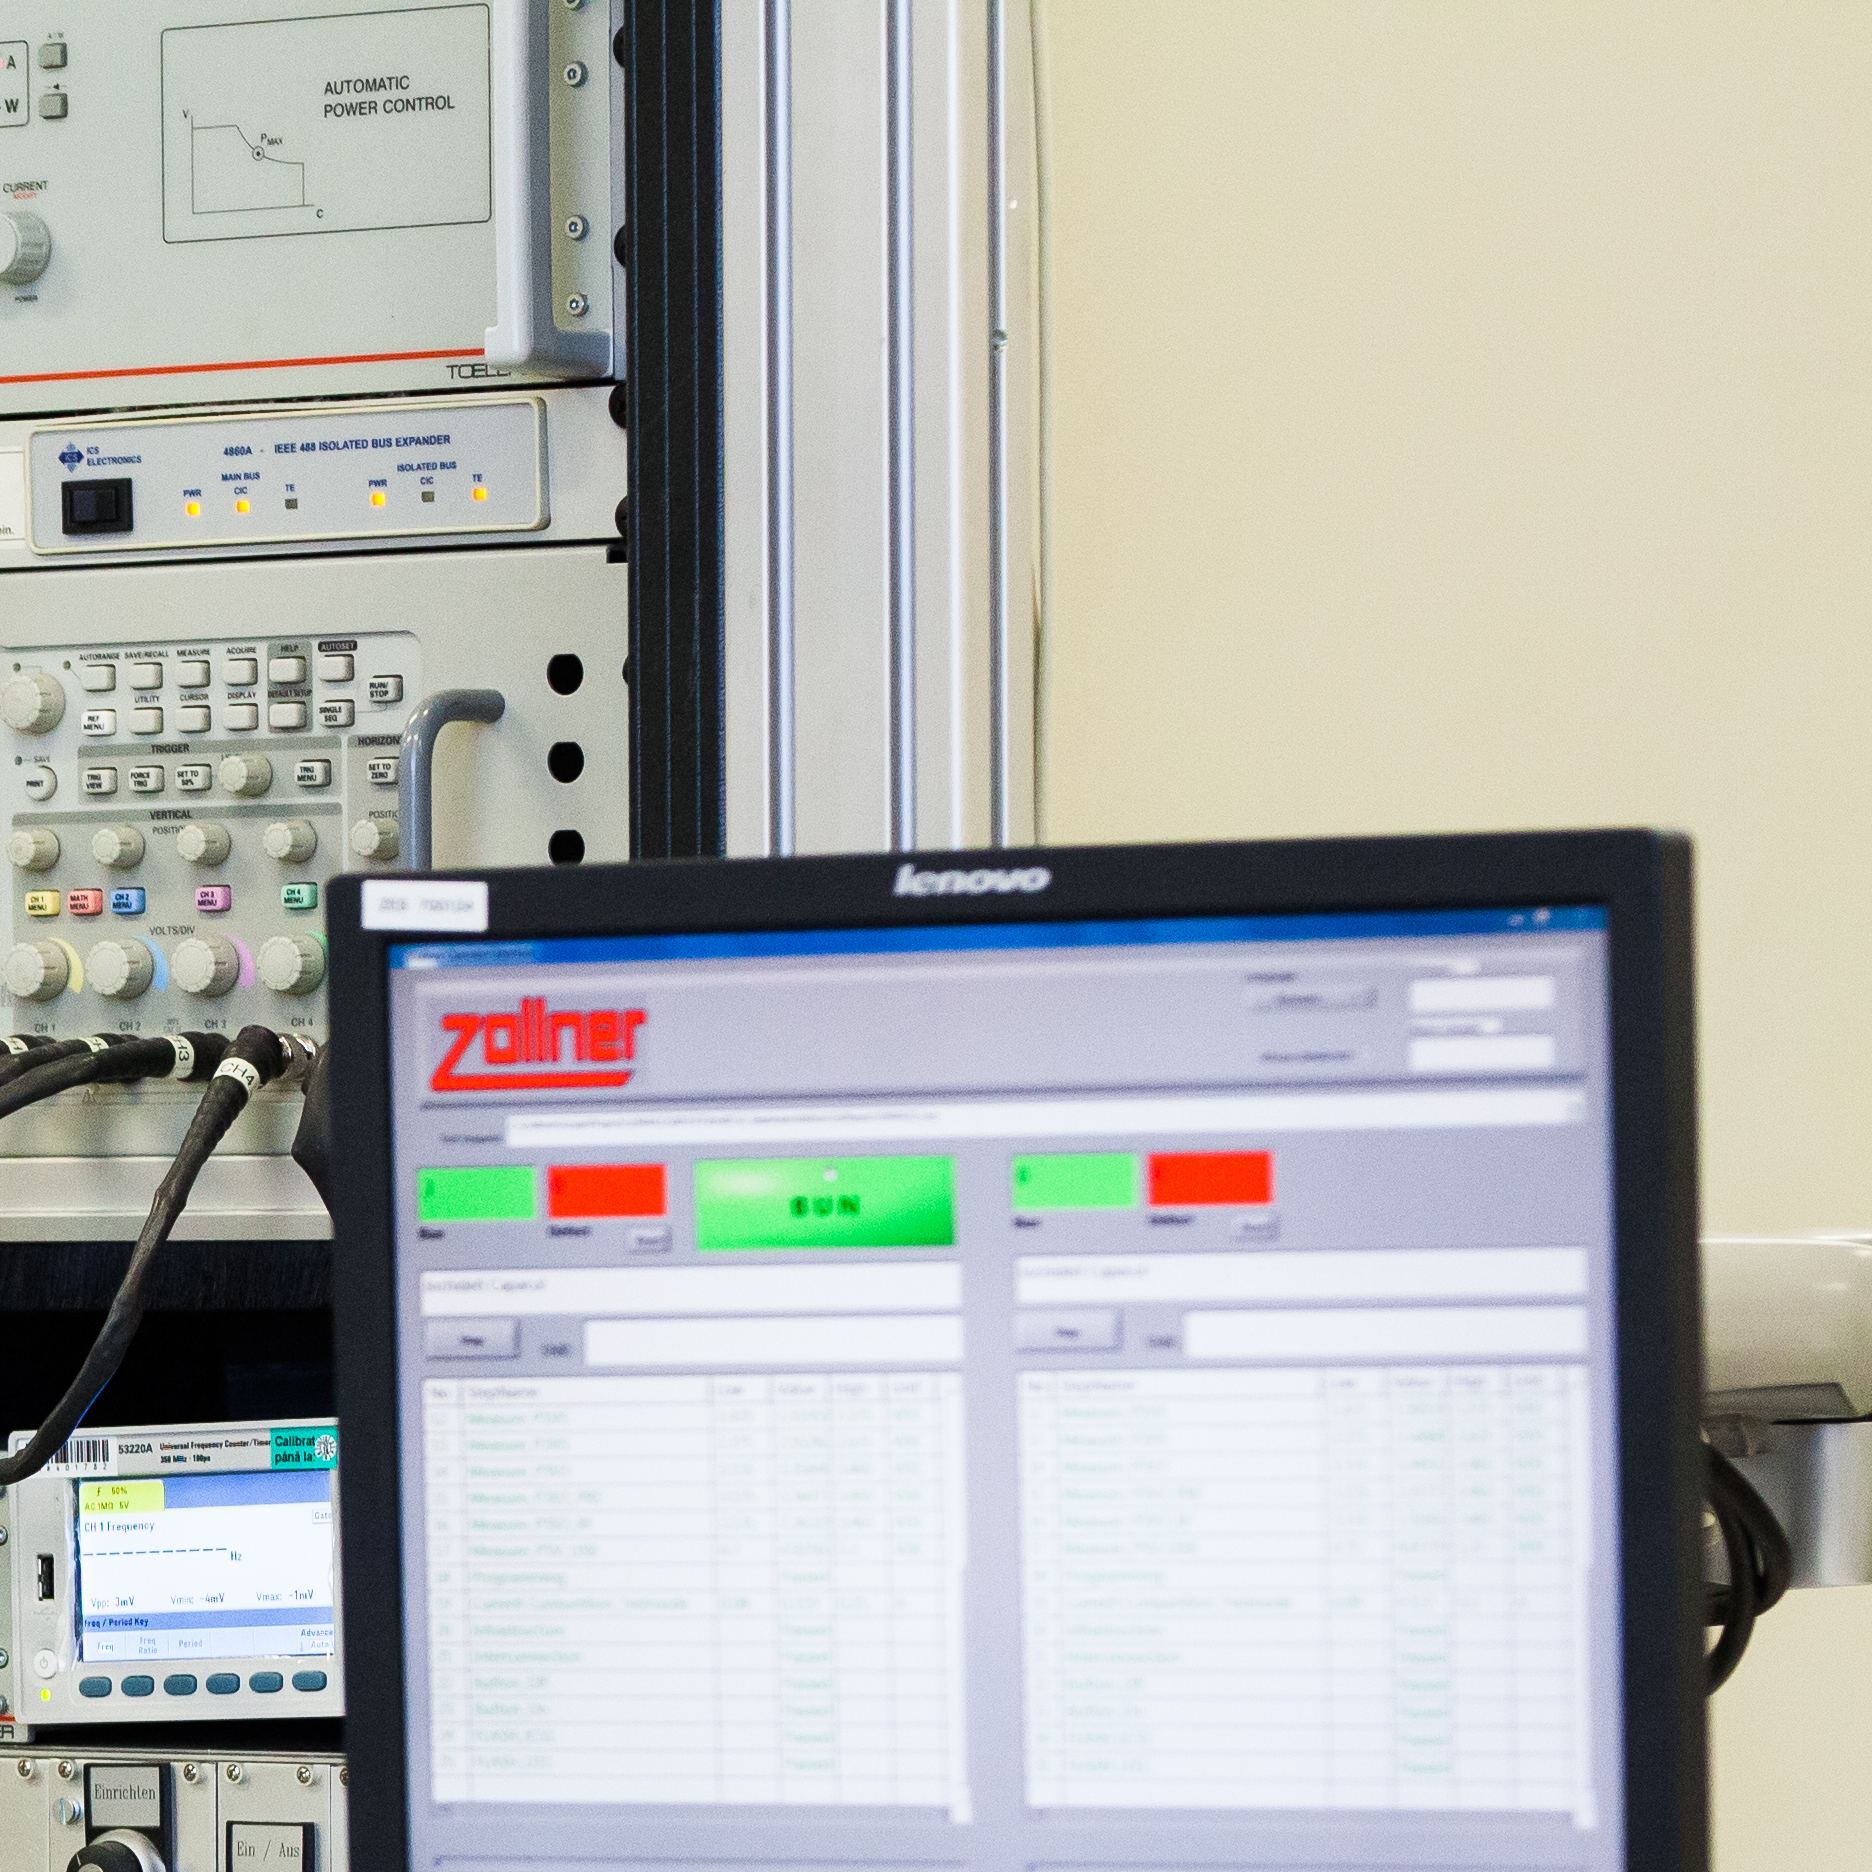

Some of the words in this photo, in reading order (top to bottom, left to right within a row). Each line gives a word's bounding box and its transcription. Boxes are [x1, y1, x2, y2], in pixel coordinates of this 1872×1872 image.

[6, 56, 16, 69] A
[323, 75, 411, 95] AUTOMATIC
[5, 99, 19, 113] W
[322, 101, 378, 119] POWER
[382, 95, 456, 115] CONTROL
[2, 180, 49, 195] CURRENT
[223, 444, 252, 457] 4860A
[274, 443, 297, 454] IEEE
[300, 442, 317, 453] 488
[319, 438, 369, 452] ISOLATED
[372, 437, 393, 449] BUS
[396, 434, 451, 447] EXPANDER
[86, 456, 142, 467] ELECTRONICS
[396, 462, 436, 473] ISOLATED
[439, 461, 457, 471] BUS
[222, 472, 241, 482] MAIN
[243, 471, 261, 481] BUS
[183, 488, 202, 499] PWR
[321, 642, 355, 651] AUTOSET
[79, 653, 120, 661] AUTORANGE
[125, 650, 169, 659] SAVE/RECALL
[370, 690, 389, 698] STOP
[319, 706, 342, 714] SINGLE
[151, 744, 190, 753] TRIGGER
[297, 774, 316, 782] MENU
[371, 771, 388, 779] ZERO
[150, 810, 192, 820] VERTICAL
[894, 863, 1050, 896] lenovo
[70, 894, 89, 903] MATH
[197, 899, 217, 907] MENU
[284, 896, 304, 905] MENU
[28, 903, 47, 911] MENU
[70, 903, 89, 911] MENU
[112, 902, 132, 910] MENU
[150, 925, 195, 936] VOLTS/DIV
[34, 1023, 48, 1033] CH
[119, 1022, 133, 1032] CH
[205, 1020, 219, 1030] CH
[291, 1018, 306, 1028] CH
[220, 1062, 255, 1086] CH4
[275, 1436, 315, 1447] Calibrat
[118, 1444, 153, 1454] 53220A
[190, 1440, 223, 1450] Frequency
[303, 1450, 315, 1462] la:
[85, 1522, 96, 1532] CH
[107, 1521, 154, 1533] Frequency
[230, 1551, 242, 1562] Hz
[115, 1596, 134, 1607] 3mV
[108, 1617, 133, 1627] Period
[135, 1617, 149, 1628] Key
[97, 1642, 113, 1652] Freq
[179, 1638, 203, 1648] Period
[138, 1646, 157, 1654] Ratio
[94, 1784, 156, 1801] Einrichten
[237, 1842, 256, 1857] Ein
[279, 1842, 300, 1858] Aus
